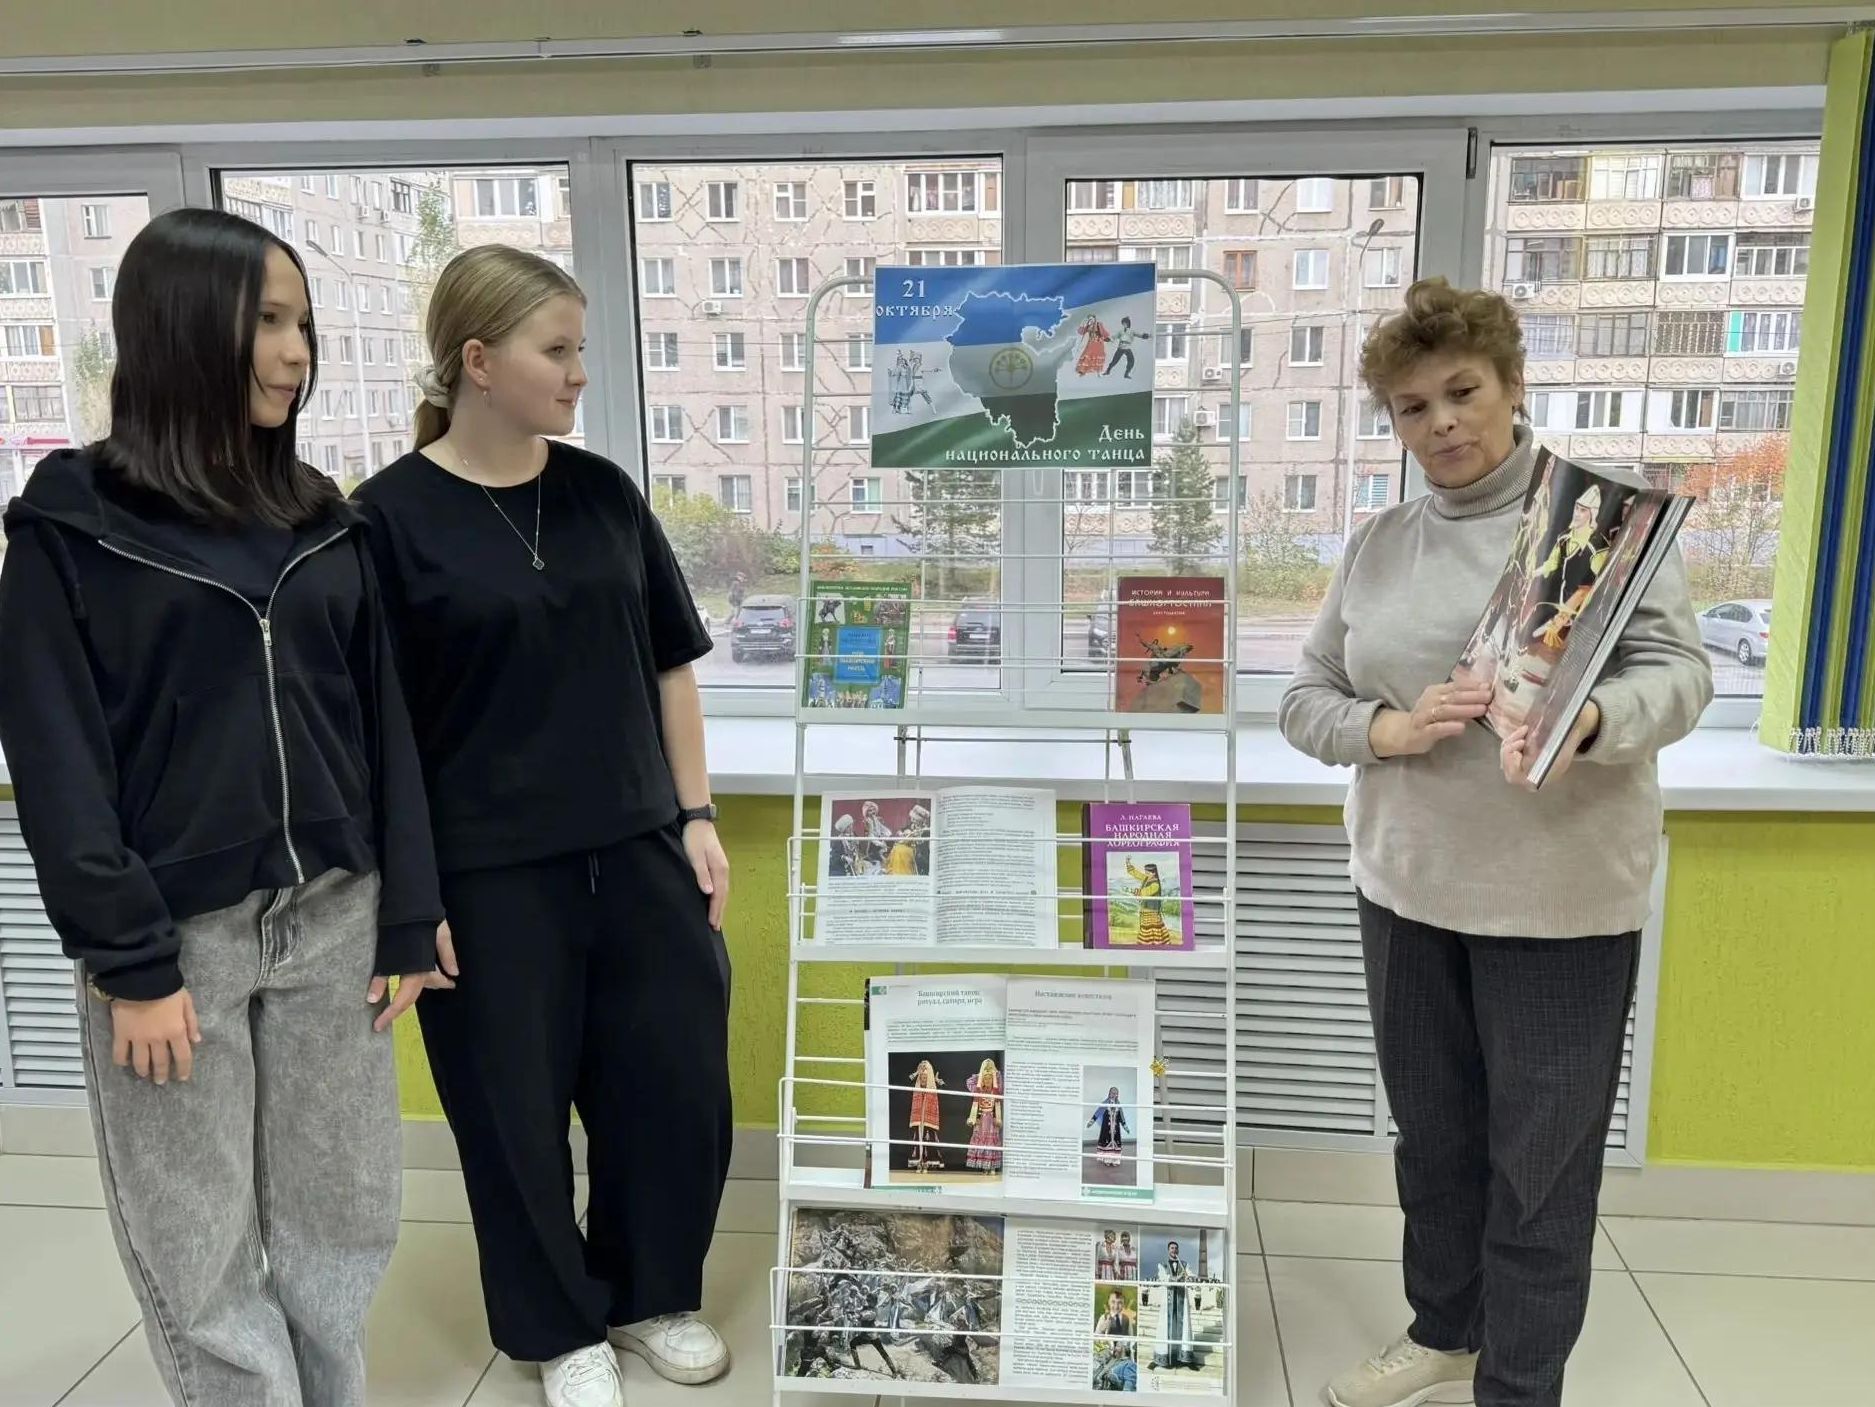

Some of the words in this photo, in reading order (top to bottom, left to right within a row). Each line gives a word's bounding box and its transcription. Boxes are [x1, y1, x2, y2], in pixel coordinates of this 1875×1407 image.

[902, 279, 925, 299] 21
[1099, 425, 1145, 442] День
[1087, 449, 1145, 463] танца
[1105, 823, 1179, 831] БАШКИРСКАЯ
